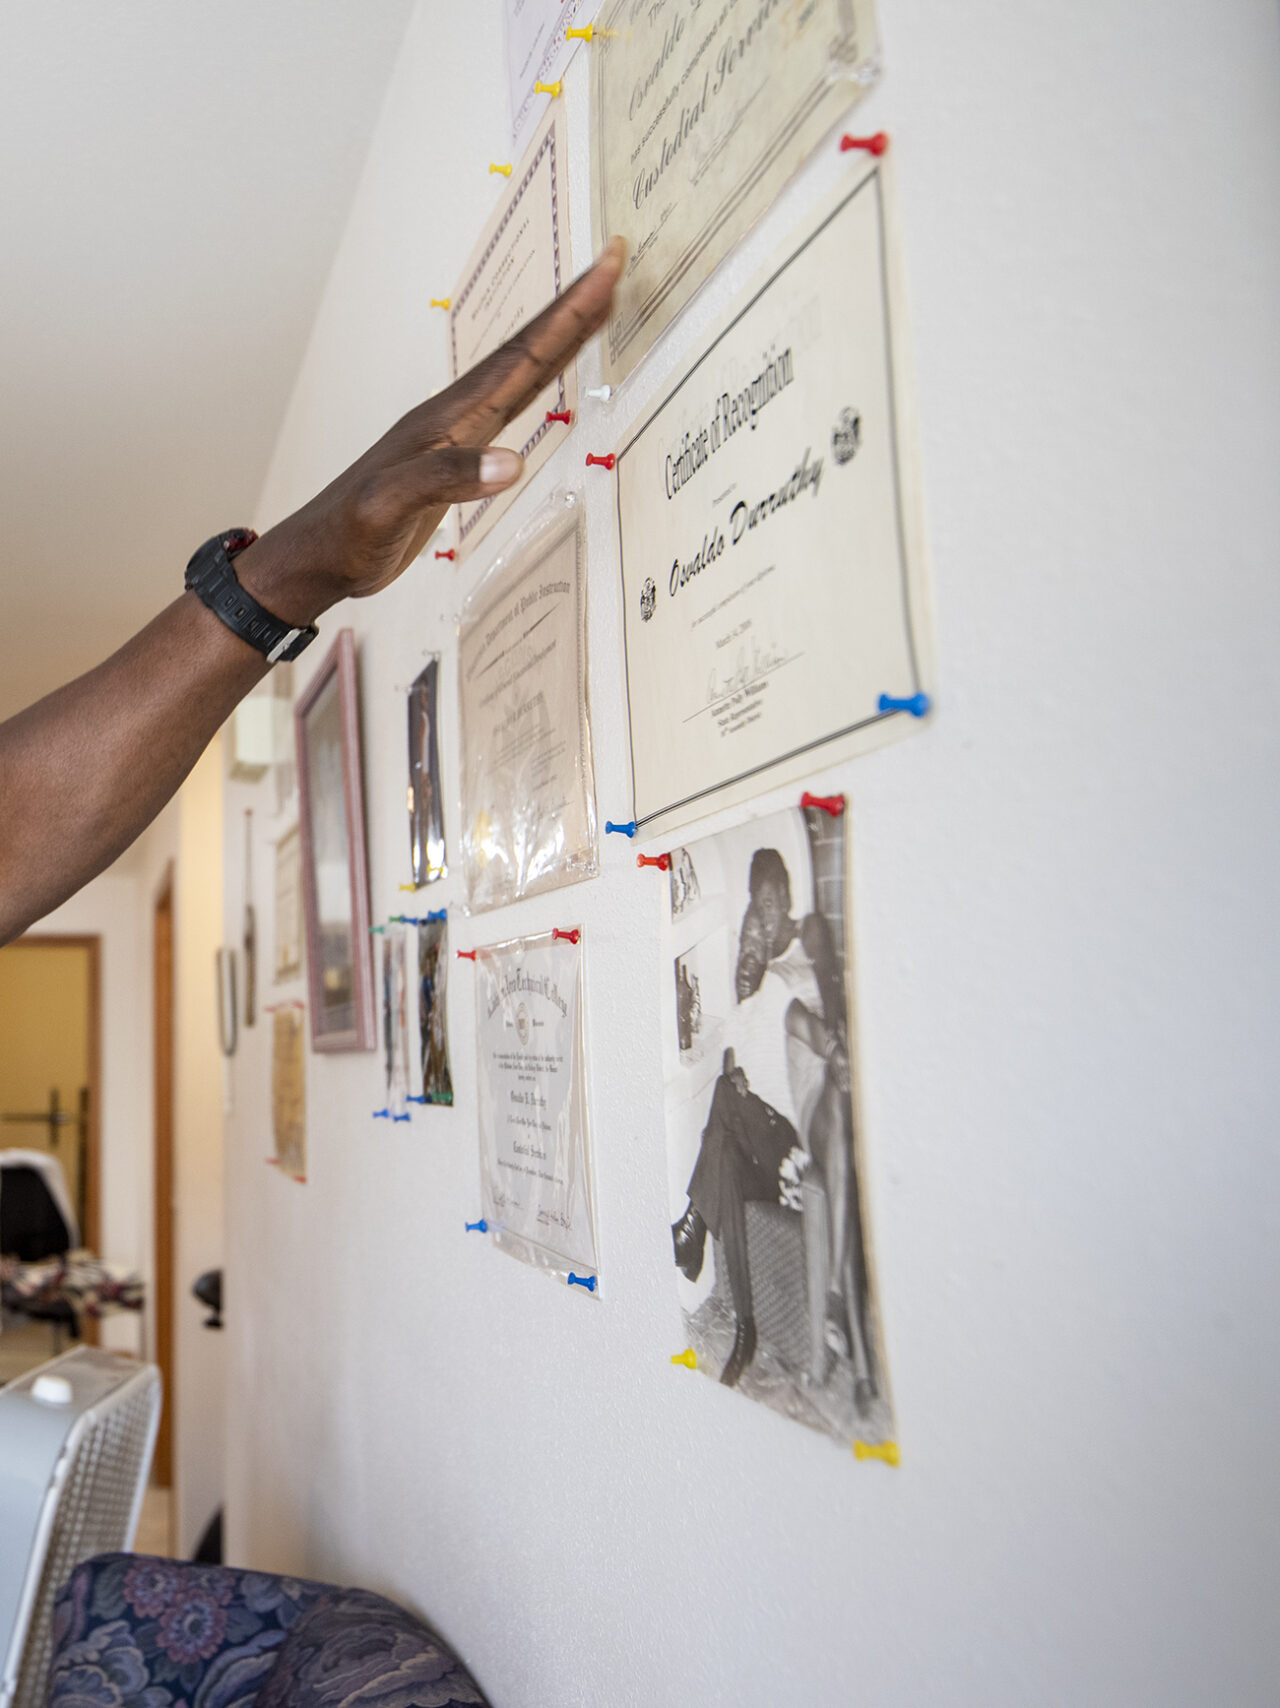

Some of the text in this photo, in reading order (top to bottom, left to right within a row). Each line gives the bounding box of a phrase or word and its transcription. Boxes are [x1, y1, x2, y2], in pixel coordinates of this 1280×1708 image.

[632, 70, 710, 210] Custodial
[665, 346, 795, 500] Certificate of Recognition
[669, 526, 725, 597] Osvaldo
